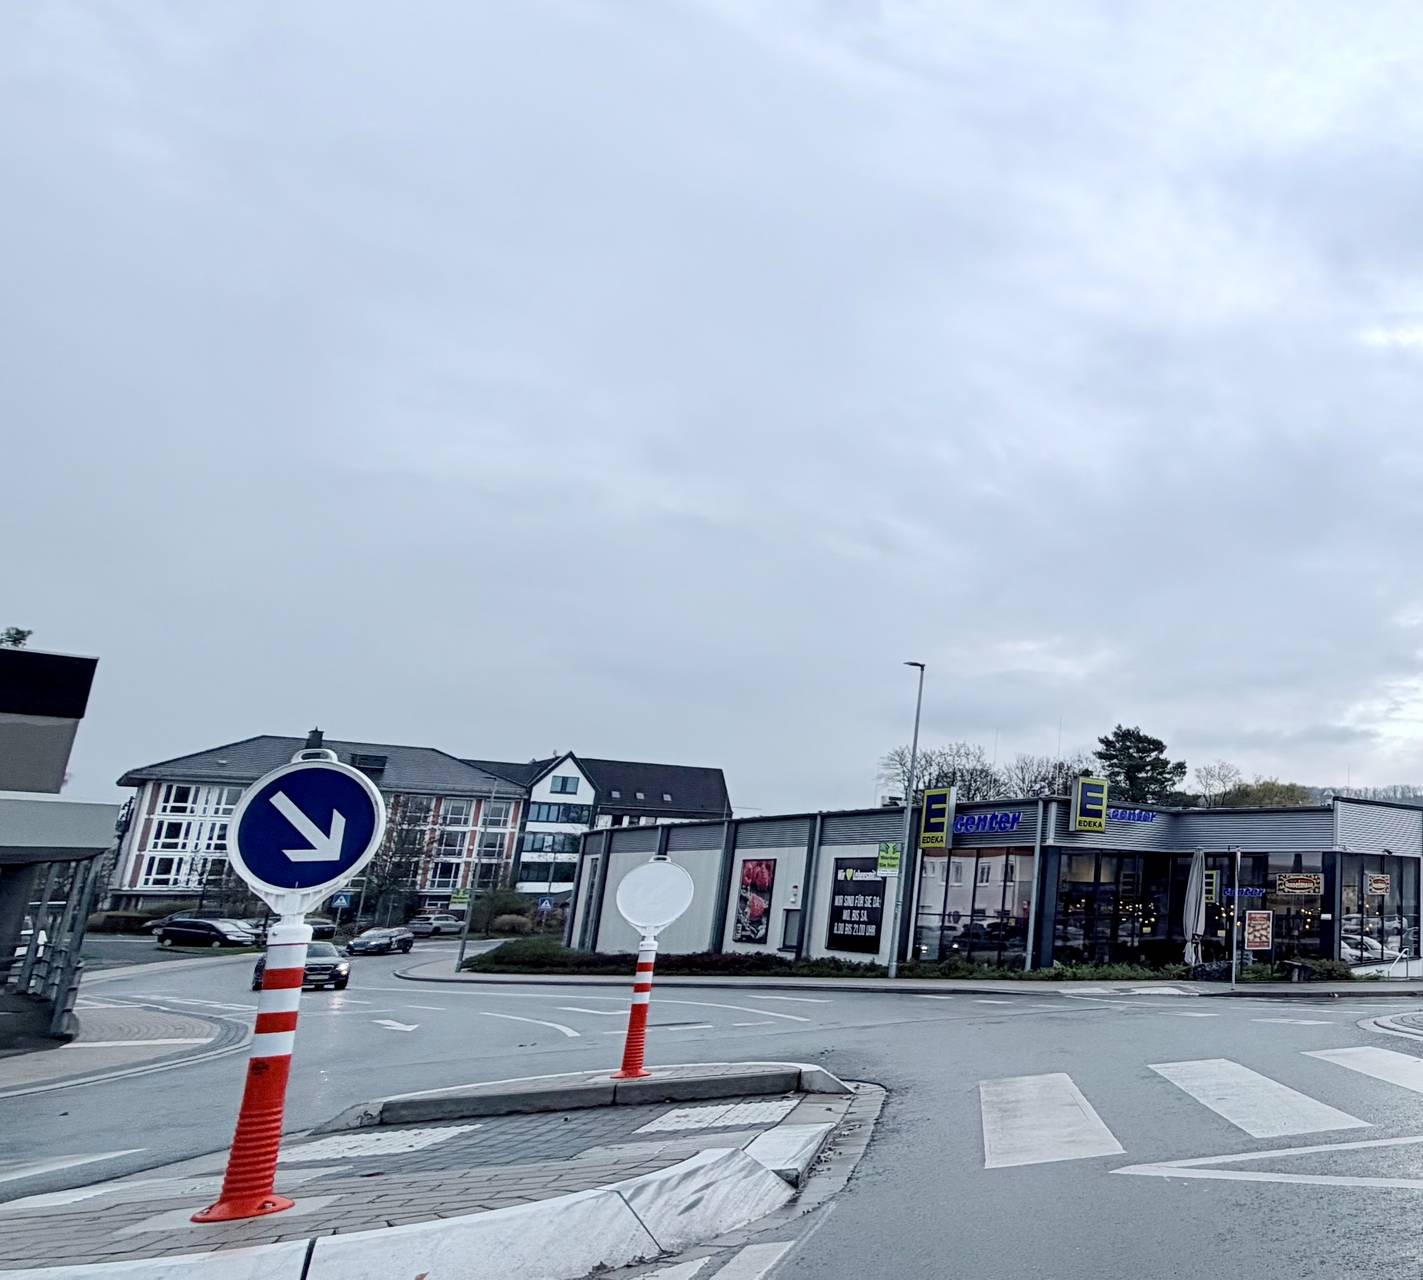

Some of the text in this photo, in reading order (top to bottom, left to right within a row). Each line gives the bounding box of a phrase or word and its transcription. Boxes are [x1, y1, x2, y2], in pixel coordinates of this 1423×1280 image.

[954, 812, 1023, 833] center
[1078, 820, 1103, 828] EDEKA
[922, 835, 944, 844] EDEKA
